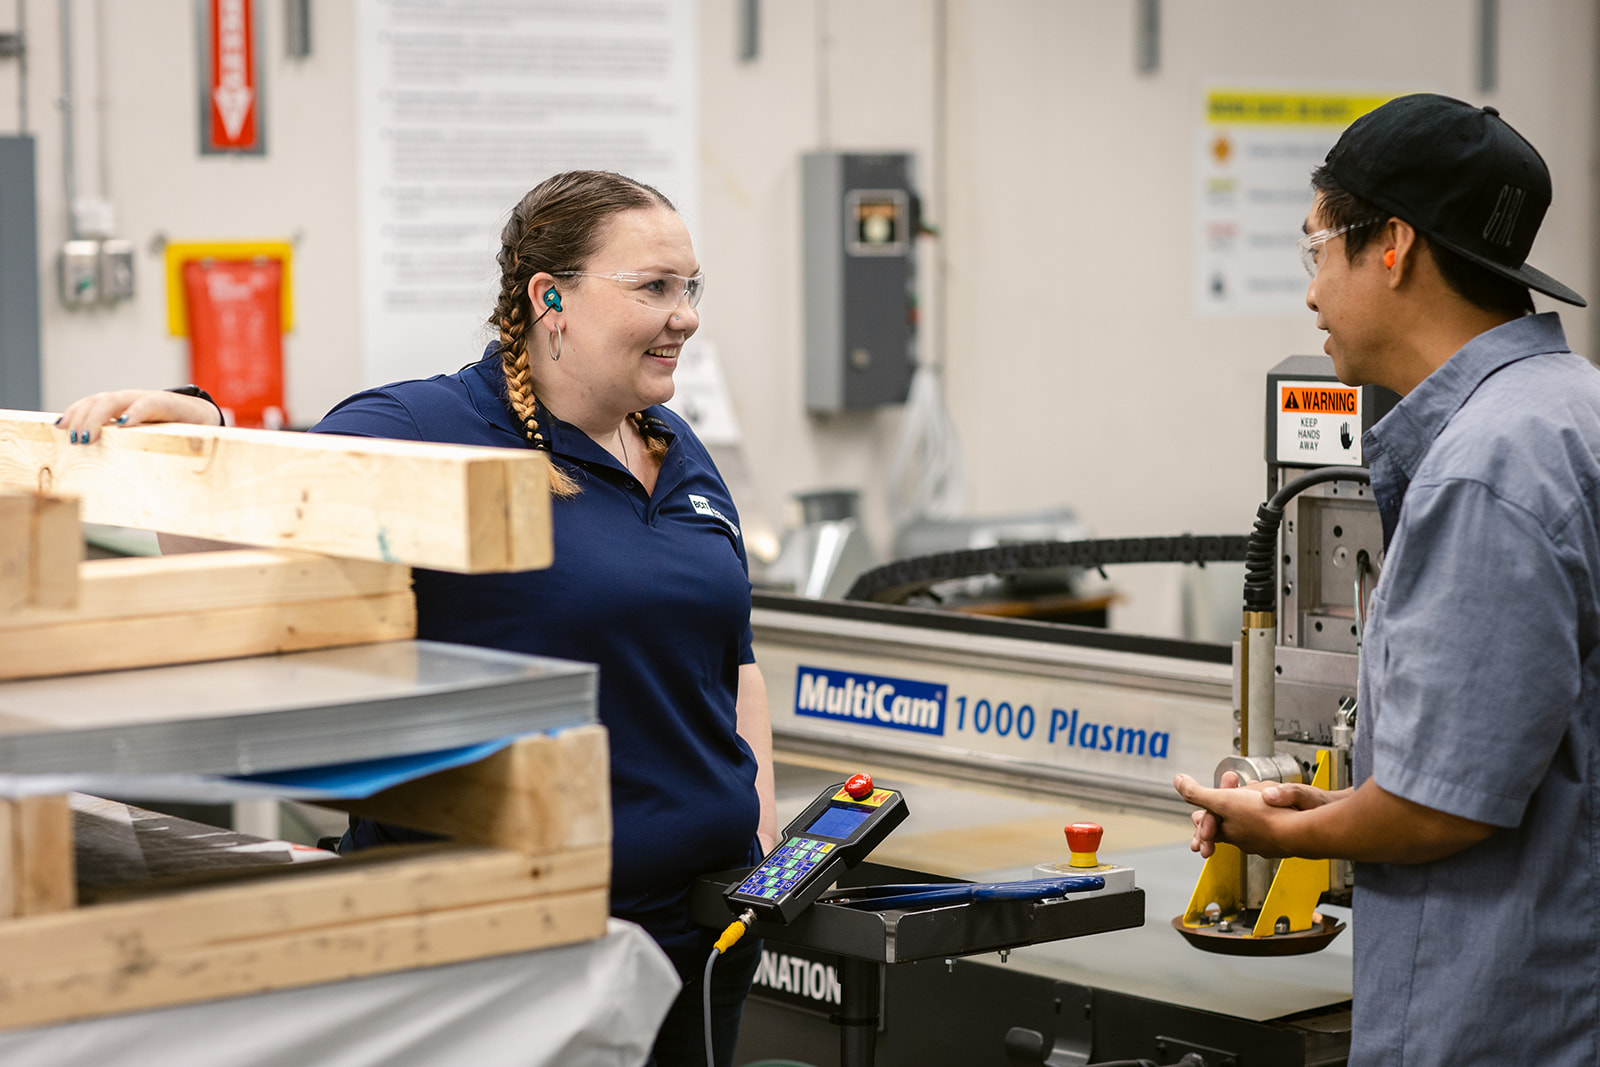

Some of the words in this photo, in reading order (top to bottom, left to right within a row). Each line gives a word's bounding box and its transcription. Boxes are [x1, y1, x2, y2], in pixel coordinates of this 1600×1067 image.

[1301, 391, 1355, 412] WARNING
[1300, 417, 1318, 427] KEEP
[1297, 429, 1320, 440] HANDS
[1299, 441, 1318, 451] AWAY
[798, 673, 940, 729] MultiCam
[954, 696, 1035, 740] 1000
[1047, 708, 1170, 759] Plasma
